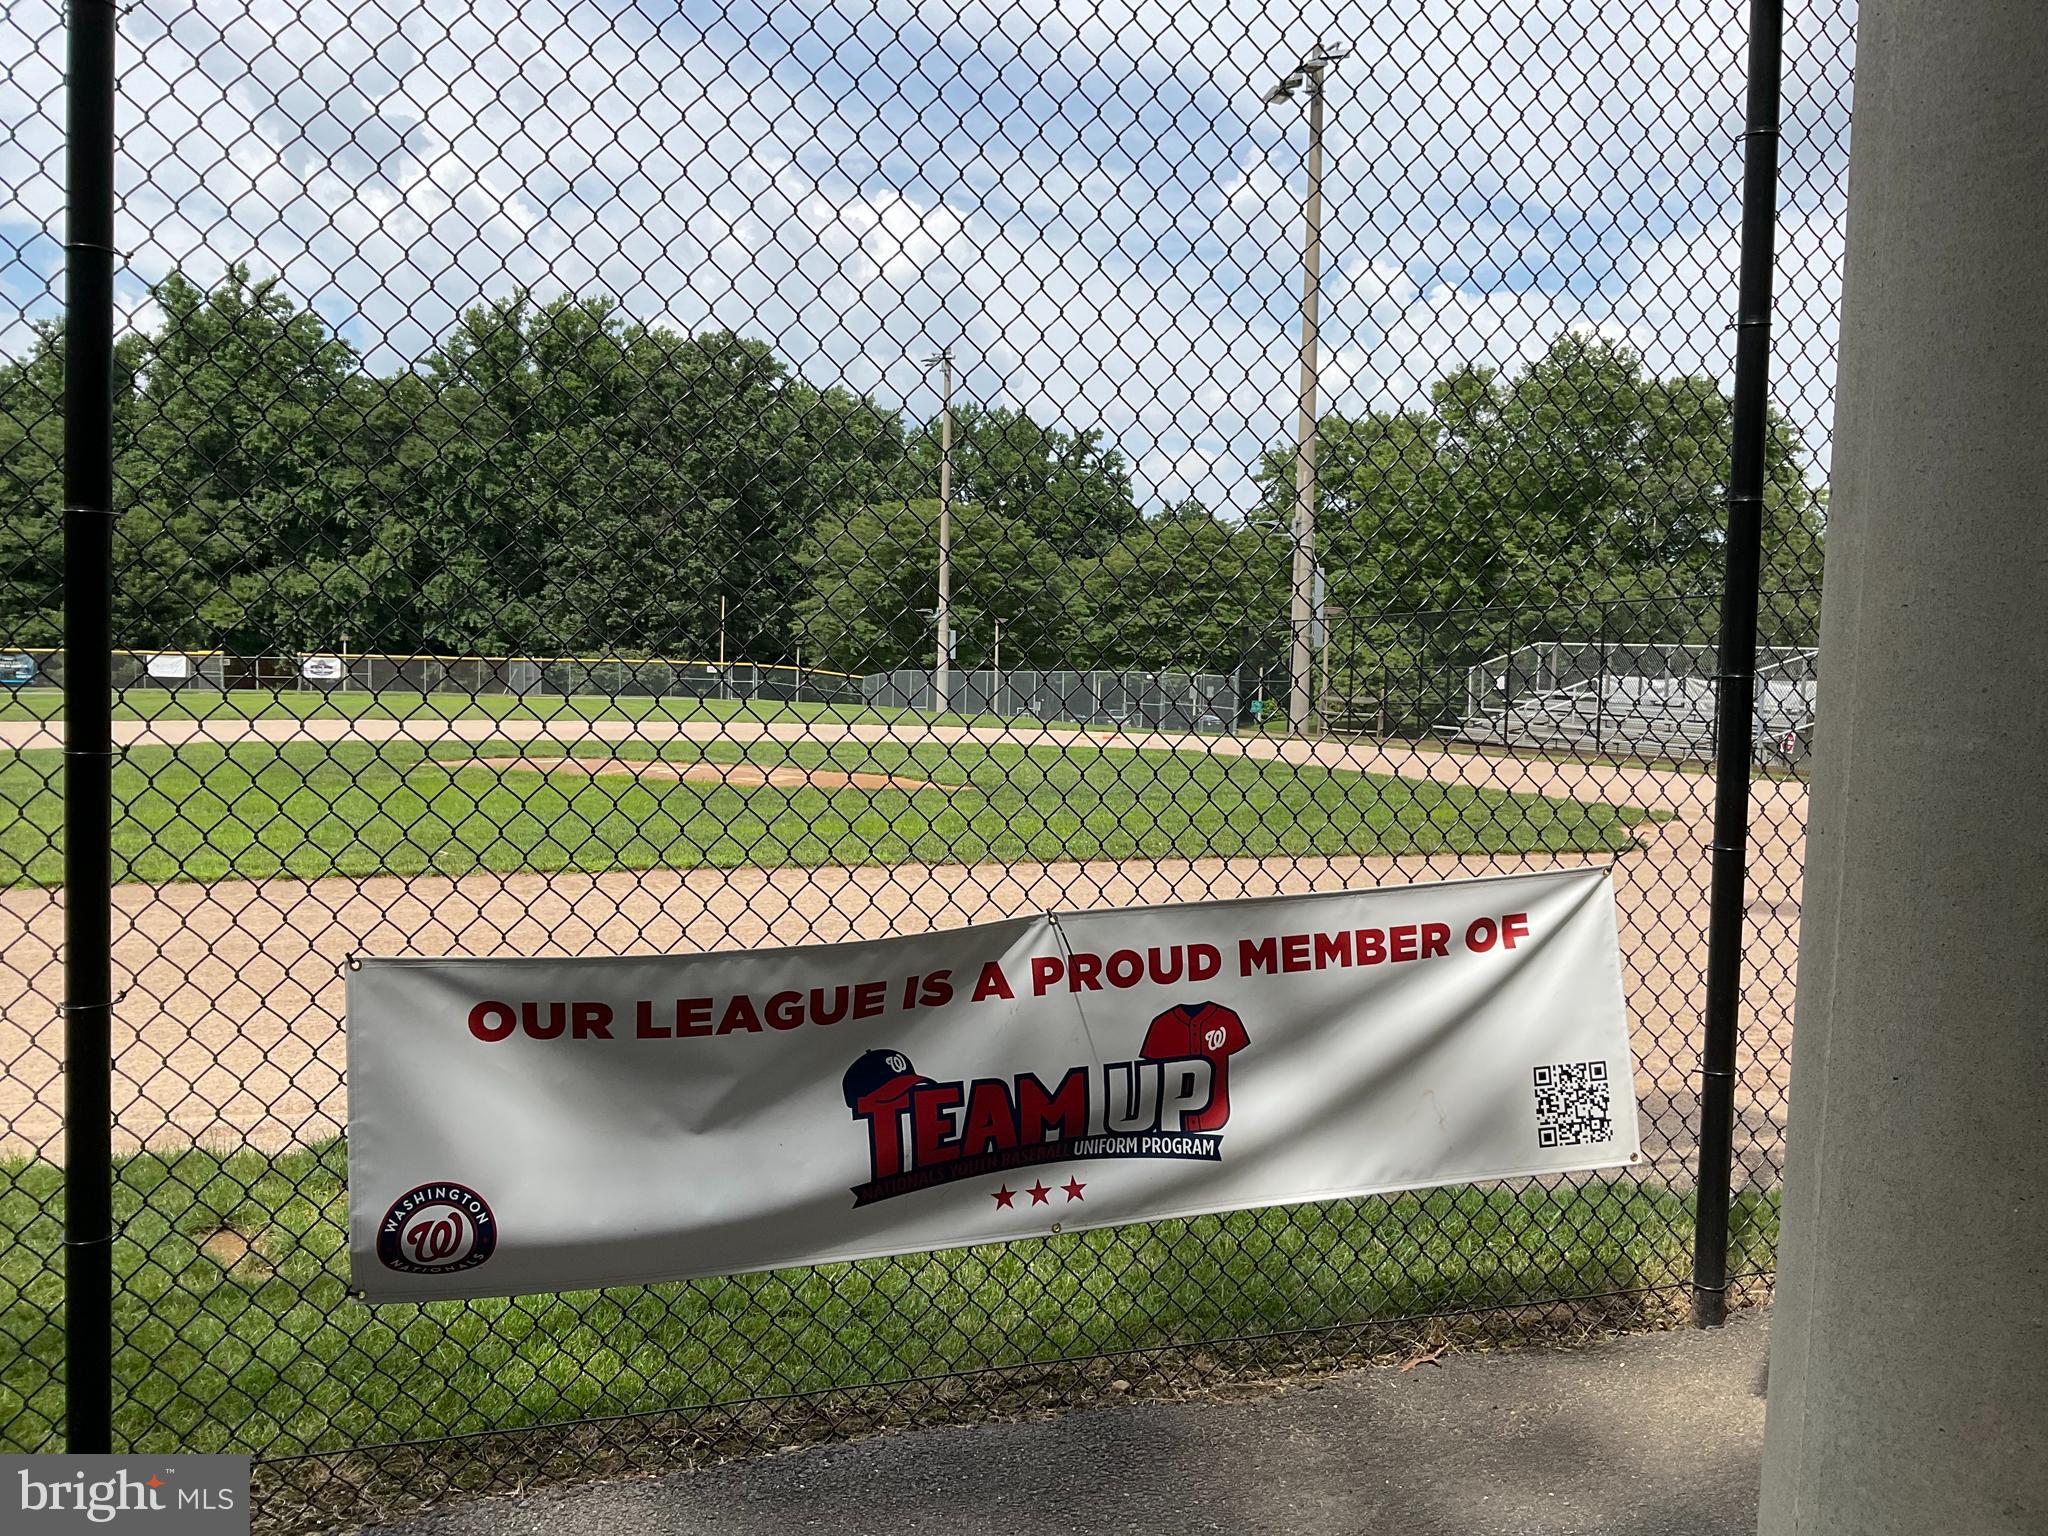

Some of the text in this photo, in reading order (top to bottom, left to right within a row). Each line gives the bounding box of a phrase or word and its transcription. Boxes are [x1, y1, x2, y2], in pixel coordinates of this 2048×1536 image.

[467, 912, 1531, 1043] OUR LEAGUE IS A PROUD MEMBER OF
[856, 1060, 1214, 1180] TEAM UP
[1074, 1136, 1138, 1156] UNIFORM
[1141, 1136, 1215, 1157] PROGRAM
[384, 1187, 489, 1233] WASHINGTON
[389, 1253, 485, 1274] NATIONALS
